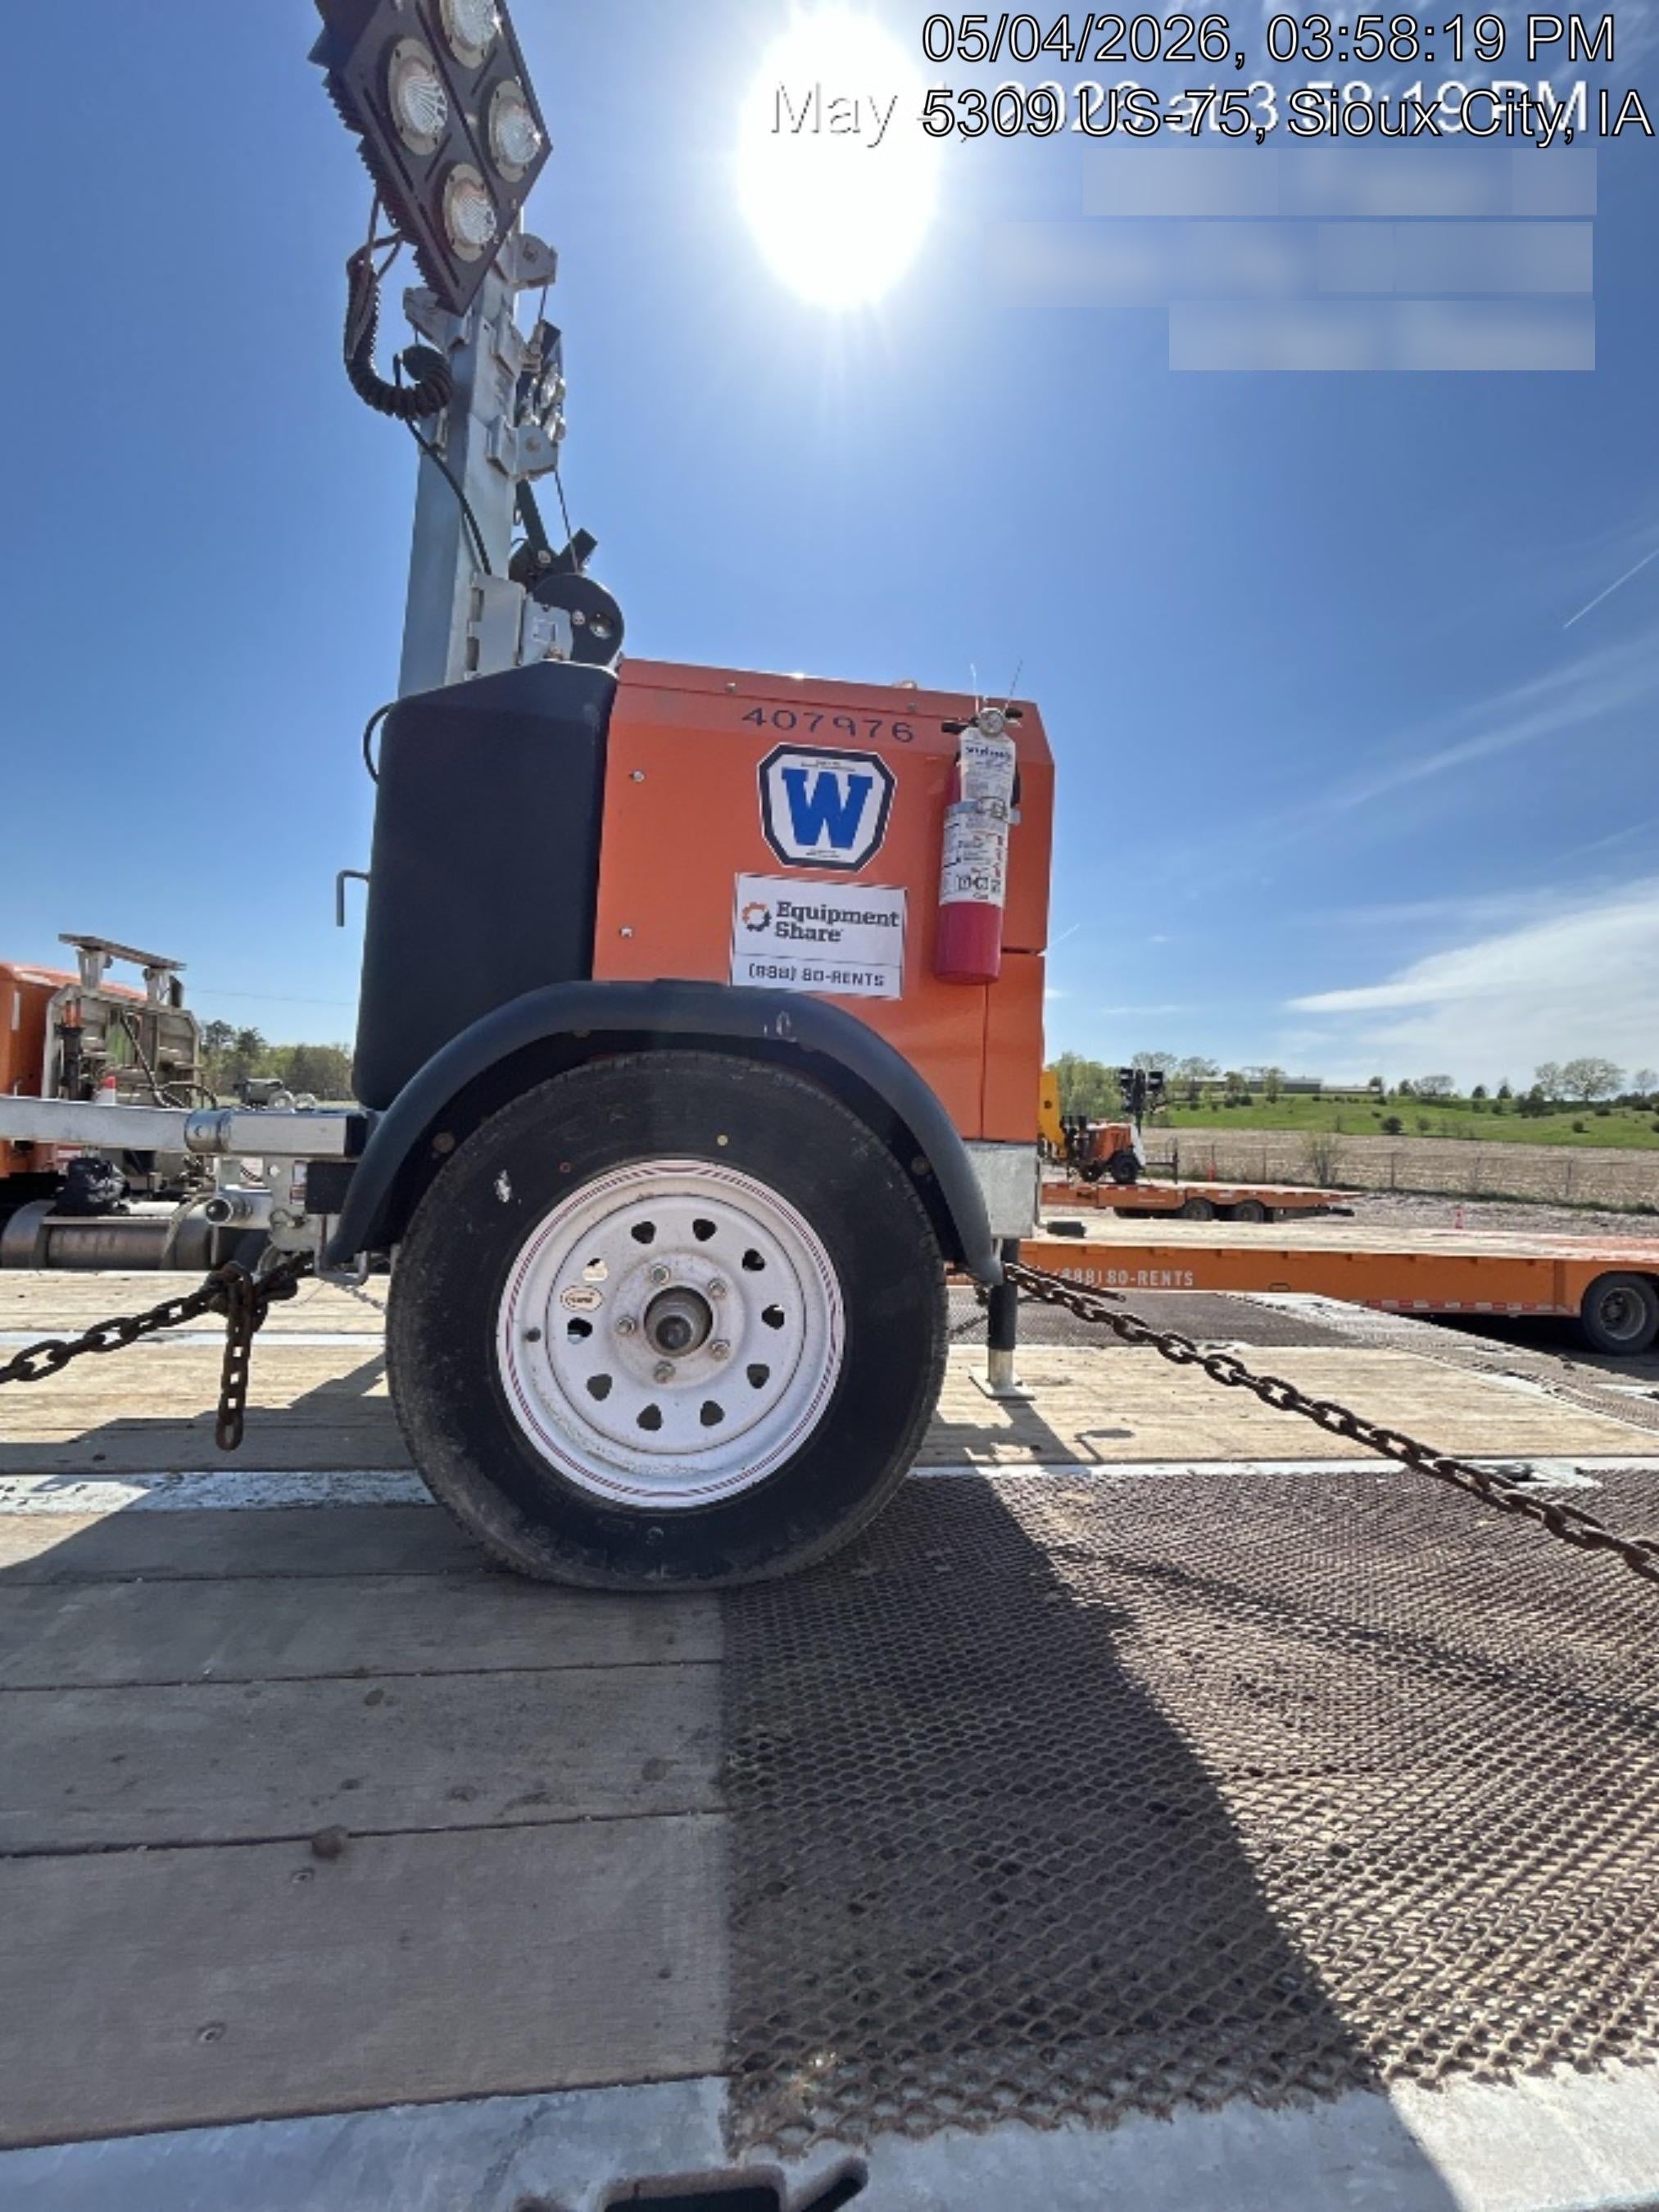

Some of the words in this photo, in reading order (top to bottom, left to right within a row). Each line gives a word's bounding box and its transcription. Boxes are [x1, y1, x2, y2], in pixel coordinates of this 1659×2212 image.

[741, 706, 913, 743] 407976
[781, 766, 873, 850] W
[776, 900, 900, 927] Equipment
[774, 921, 841, 942] Share
[802, 968, 885, 986] 80-RENTS
[1106, 1269, 1194, 1287] 80-RENTS
